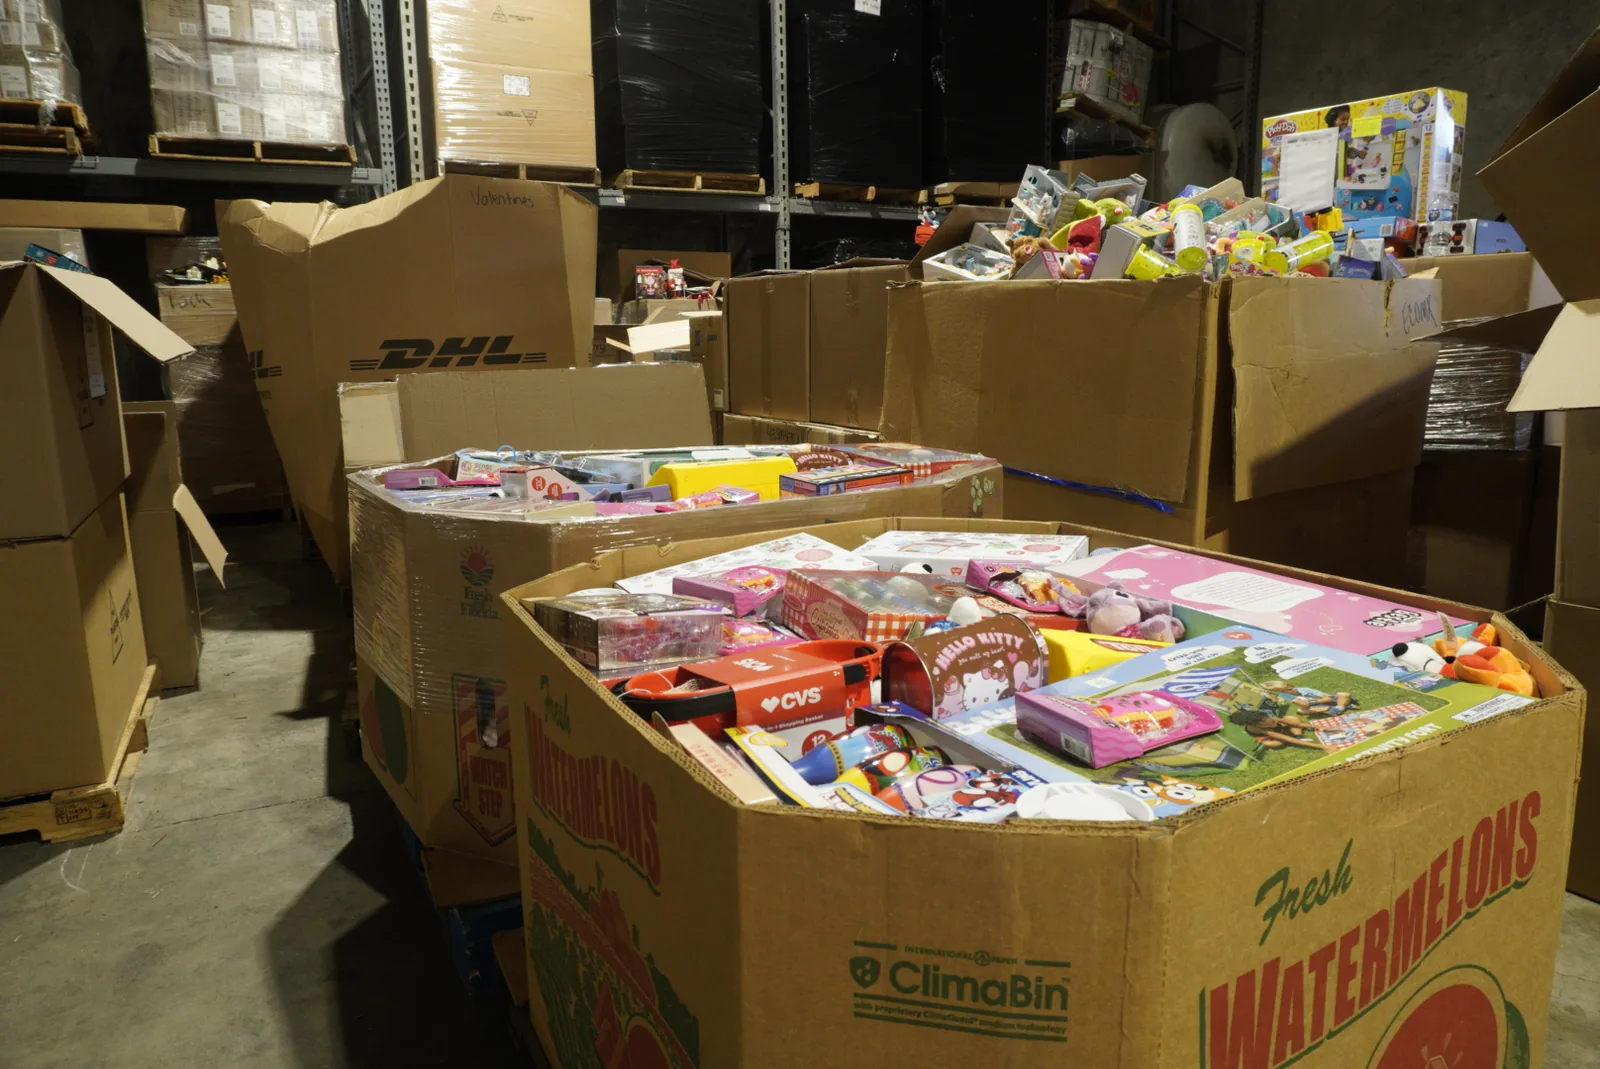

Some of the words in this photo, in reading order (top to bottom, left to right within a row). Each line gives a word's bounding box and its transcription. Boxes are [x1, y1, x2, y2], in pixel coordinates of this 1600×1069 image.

[1265, 119, 1297, 136] Play-Doh
[379, 336, 523, 369] DHL
[819, 453, 843, 464] KITTY
[935, 636, 976, 671] HELLO
[976, 632, 1024, 650] KITTY
[781, 686, 822, 710] CVS
[779, 718, 805, 730] Shopping
[805, 714, 824, 723] Basket
[1407, 722, 1443, 742] FORT
[812, 733, 827, 745] 12
[469, 754, 508, 790] WATCH
[478, 786, 503, 819] STEP
[524, 702, 662, 887] WATERMELONS
[1254, 838, 1353, 947] Fresh
[1209, 790, 1541, 1069] WATERMELONS
[904, 945, 974, 961] INTERNATIONAL
[991, 956, 1017, 965] PAPER
[889, 960, 1069, 1011] ClimaBin
[854, 1001, 873, 1011] with
[874, 1003, 922, 1018] proprietary
[979, 1018, 1015, 1029] medium
[1016, 1021, 1067, 1034] technology
